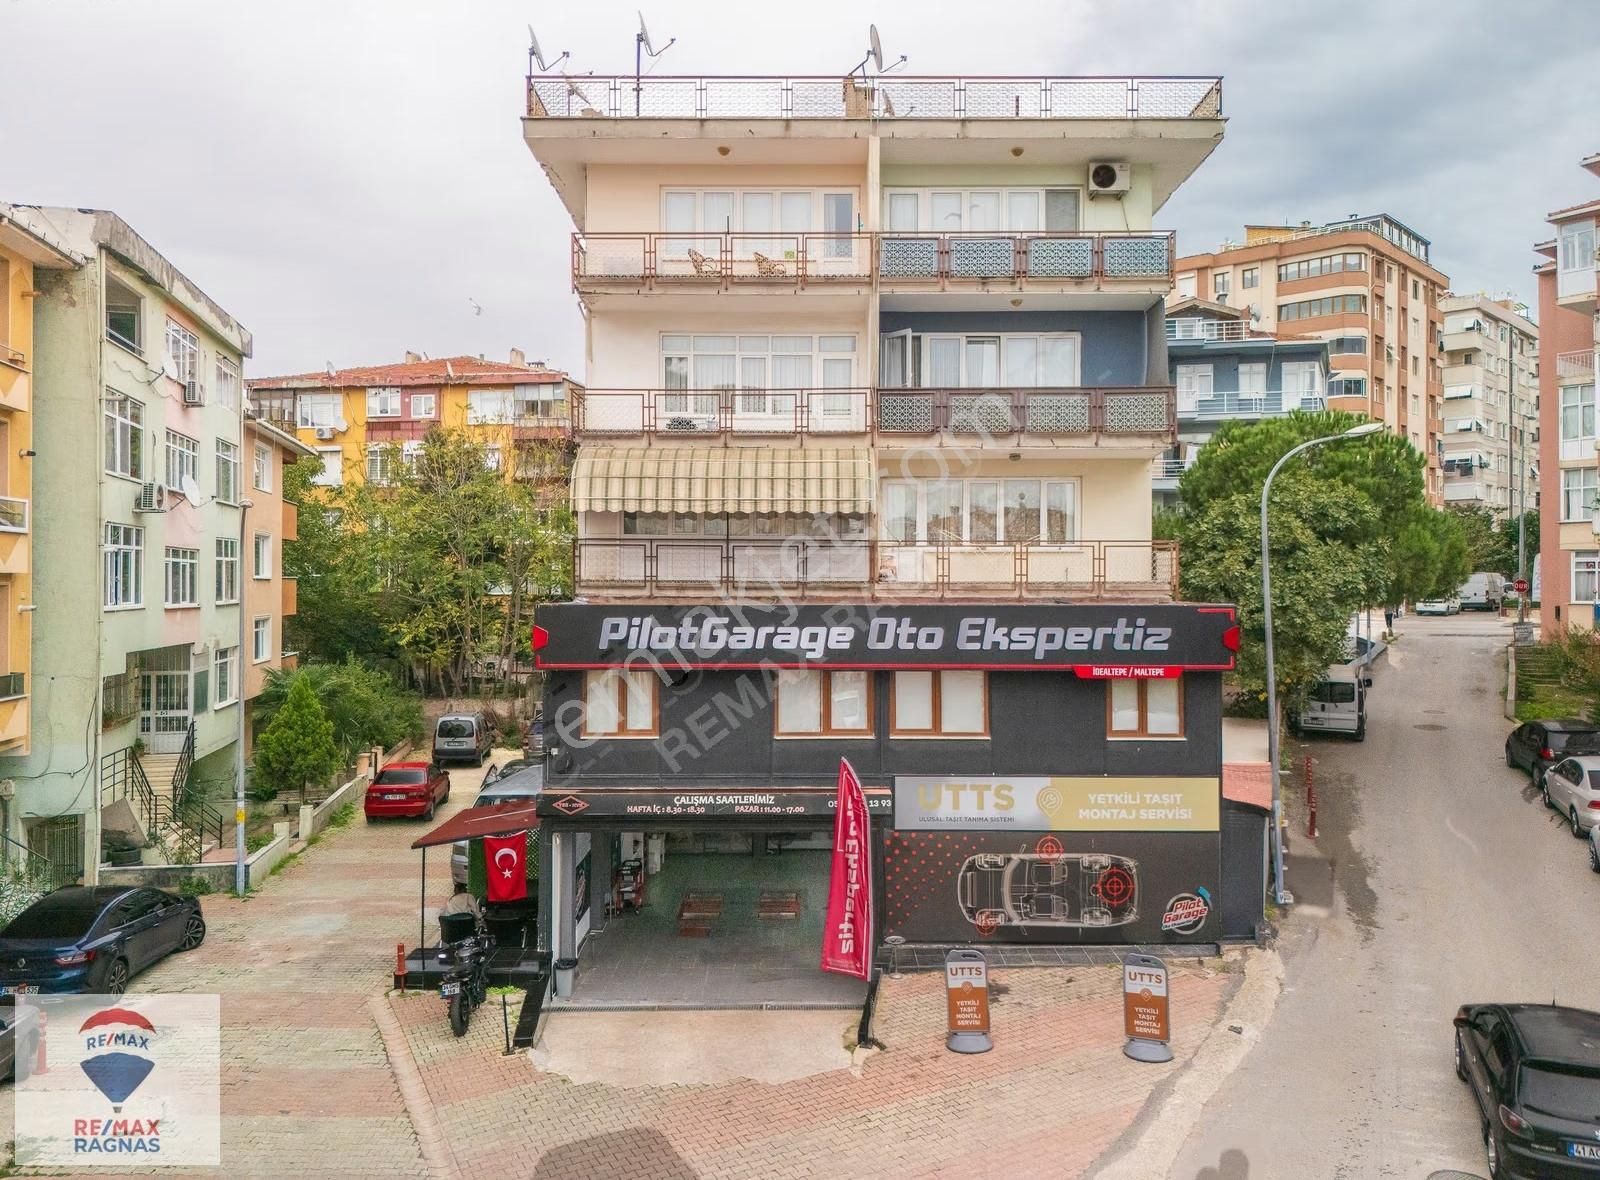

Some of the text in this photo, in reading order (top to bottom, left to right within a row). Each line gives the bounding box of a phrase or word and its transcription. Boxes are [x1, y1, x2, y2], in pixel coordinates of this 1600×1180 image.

[598, 616, 1172, 660] PilotGarage Oto Ekspertiz
[1134, 667, 1164, 676] MALTEPE
[674, 794, 775, 806] ÇALIŞMA SAATLERİMİZ
[881, 799, 891, 807] 93
[917, 783, 1015, 811] UTTS
[1088, 791, 1183, 806] YETKİLİ TAŞIT
[627, 805, 652, 813] HAFTA
[666, 806, 682, 814] 8.30
[687, 806, 705, 814] 18.30
[735, 805, 759, 813] PAZAR
[786, 806, 805, 814] 17.00
[1078, 808, 1136, 819] MONTAJ
[1174, 897, 1202, 912] Pilot
[1163, 907, 1207, 924] Garage
[950, 967, 982, 976] UTTS
[1128, 971, 1163, 984] UTTS
[1134, 1020, 1161, 1028] MONTAJ
